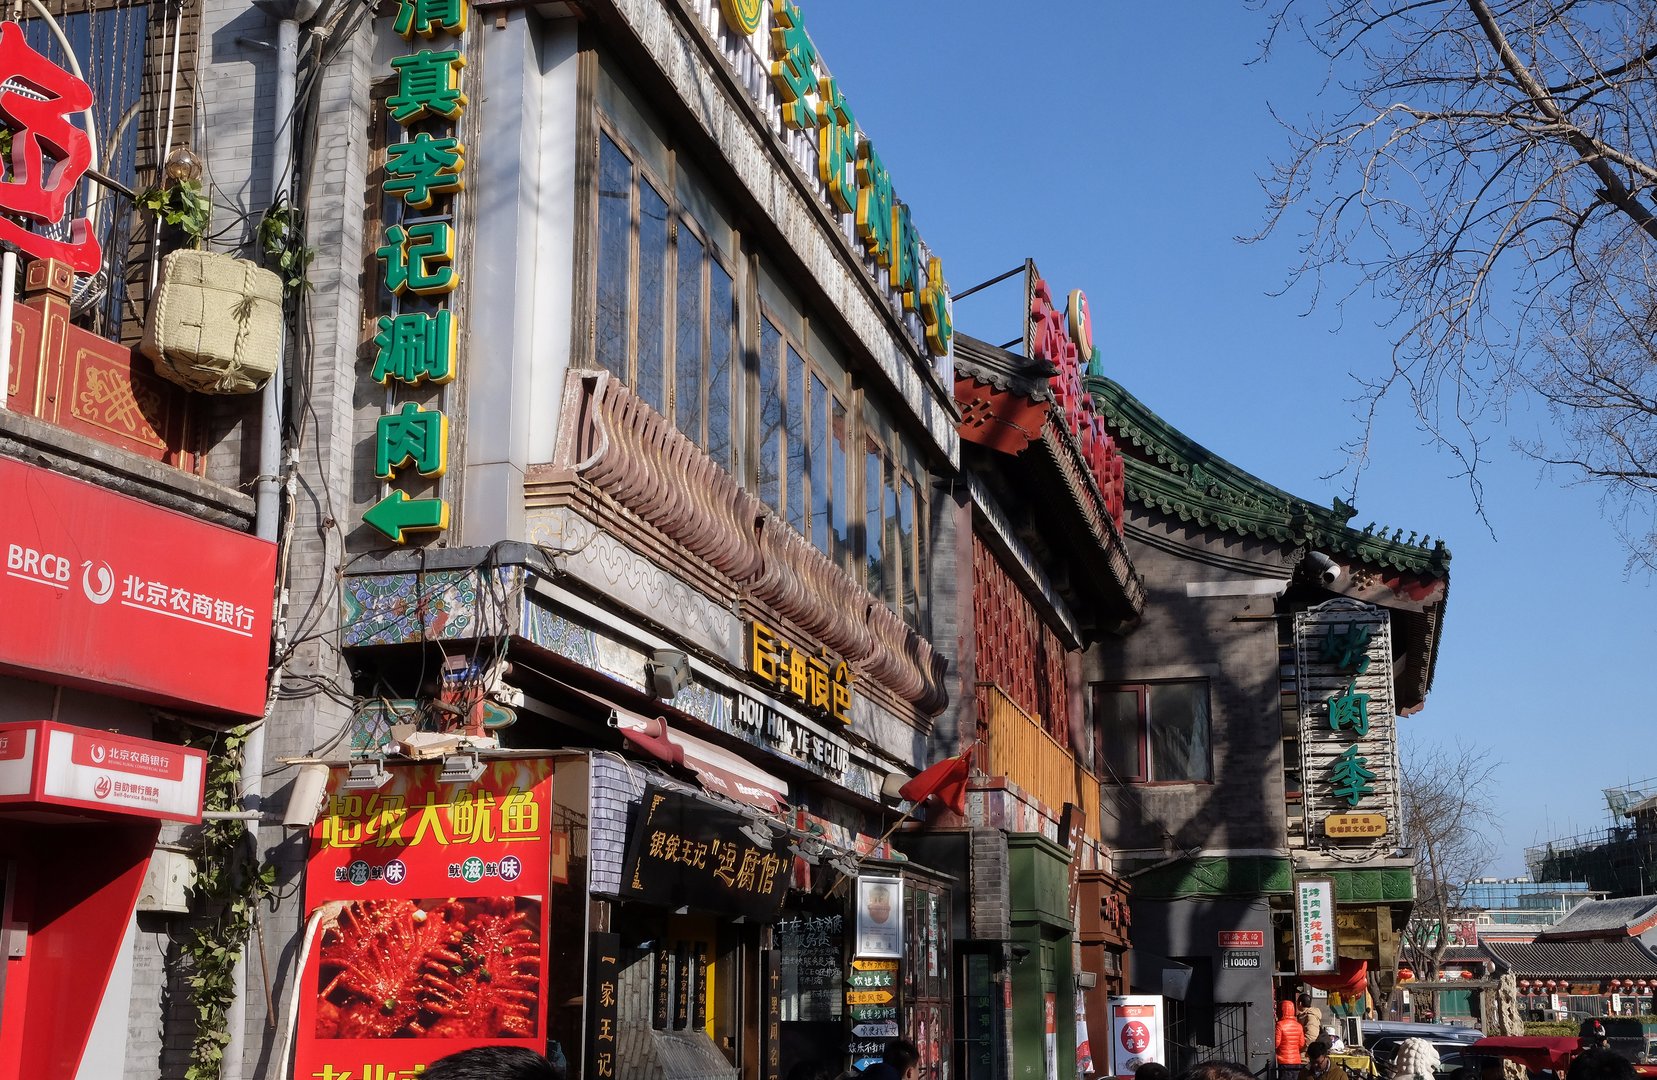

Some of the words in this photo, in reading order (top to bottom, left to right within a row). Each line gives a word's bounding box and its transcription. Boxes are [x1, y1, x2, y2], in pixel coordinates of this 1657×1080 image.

[7, 543, 71, 582] BRCB
[121, 574, 255, 631] 北京农商银行
[753, 620, 852, 725] 后海夜色
[738, 693, 764, 730] HOU
[796, 725, 810, 754] YE
[1320, 618, 1377, 806] 烤肉季
[108, 747, 169, 768] 北京农商银行
[113, 791, 140, 801] Self-Service
[114, 781, 160, 798] 自助银行服务
[321, 787, 541, 849] 超级大鱿鱼
[334, 859, 407, 886] 鱿滋鱿味
[448, 855, 522, 882] 鱿滋鱿味
[1230, 958, 1258, 967] 100009
[853, 975, 892, 987] 欢迎美女
[597, 955, 616, 1078] 一家王记
[1125, 1026, 1145, 1037] 全天
[1125, 1038, 1146, 1049] 营业
